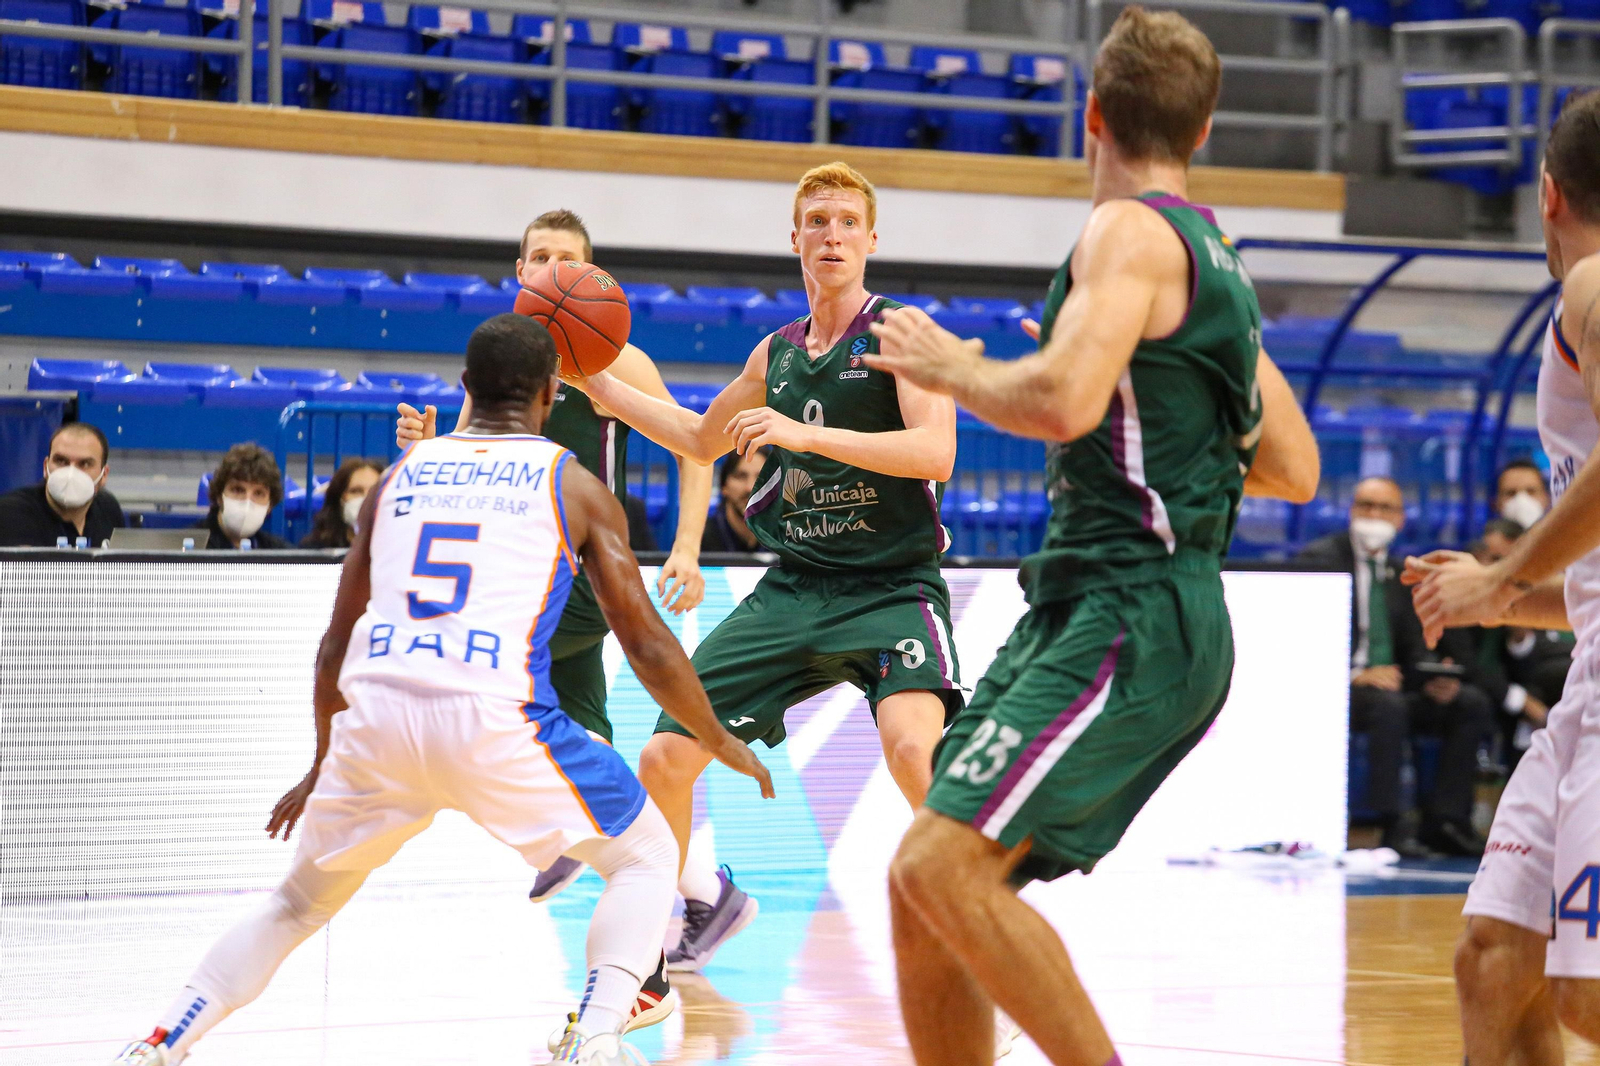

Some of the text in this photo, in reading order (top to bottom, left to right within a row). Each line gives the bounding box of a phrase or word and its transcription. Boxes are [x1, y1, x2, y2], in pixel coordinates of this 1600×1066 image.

[395, 461, 545, 491] NEEDHAM
[419, 494, 529, 516] PORT OF BAR
[811, 481, 878, 505] Unicaja
[784, 510, 876, 544] Andalucía
[405, 521, 481, 621] 5
[368, 623, 501, 669] BAR
[895, 638, 926, 670] 9
[945, 718, 1024, 785] 23
